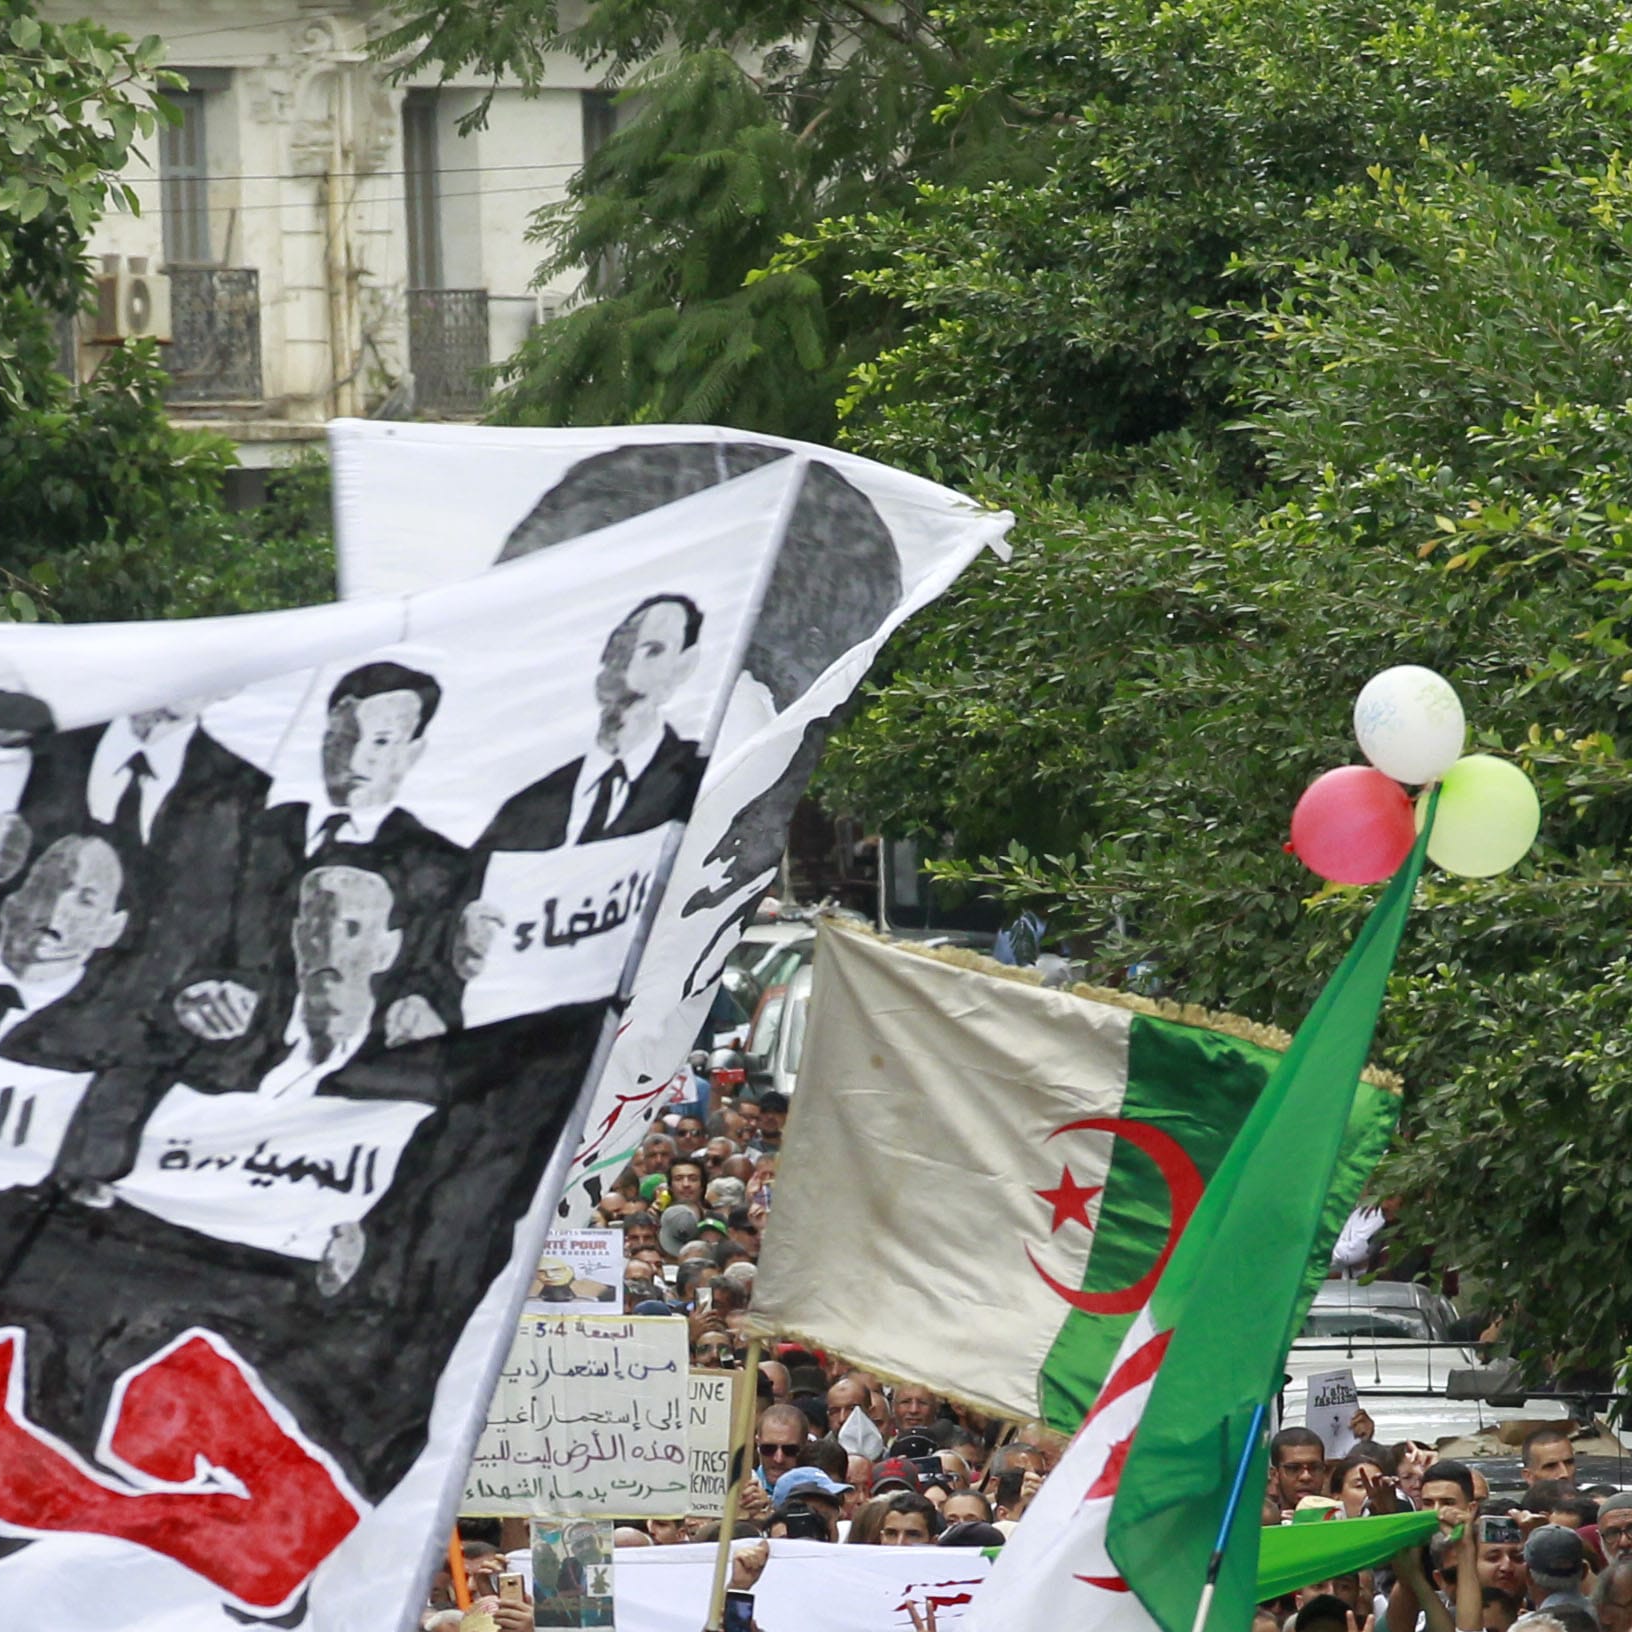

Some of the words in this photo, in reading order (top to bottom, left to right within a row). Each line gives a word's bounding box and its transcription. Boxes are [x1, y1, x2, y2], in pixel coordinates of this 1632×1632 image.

[513, 869, 651, 953] القضاء
[571, 1240, 607, 1250] POUR
[628, 1359, 677, 1380] من
[647, 1398, 683, 1430] إلى
[631, 1439, 685, 1464] هذه
[465, 1477, 543, 1500] الشهداء
